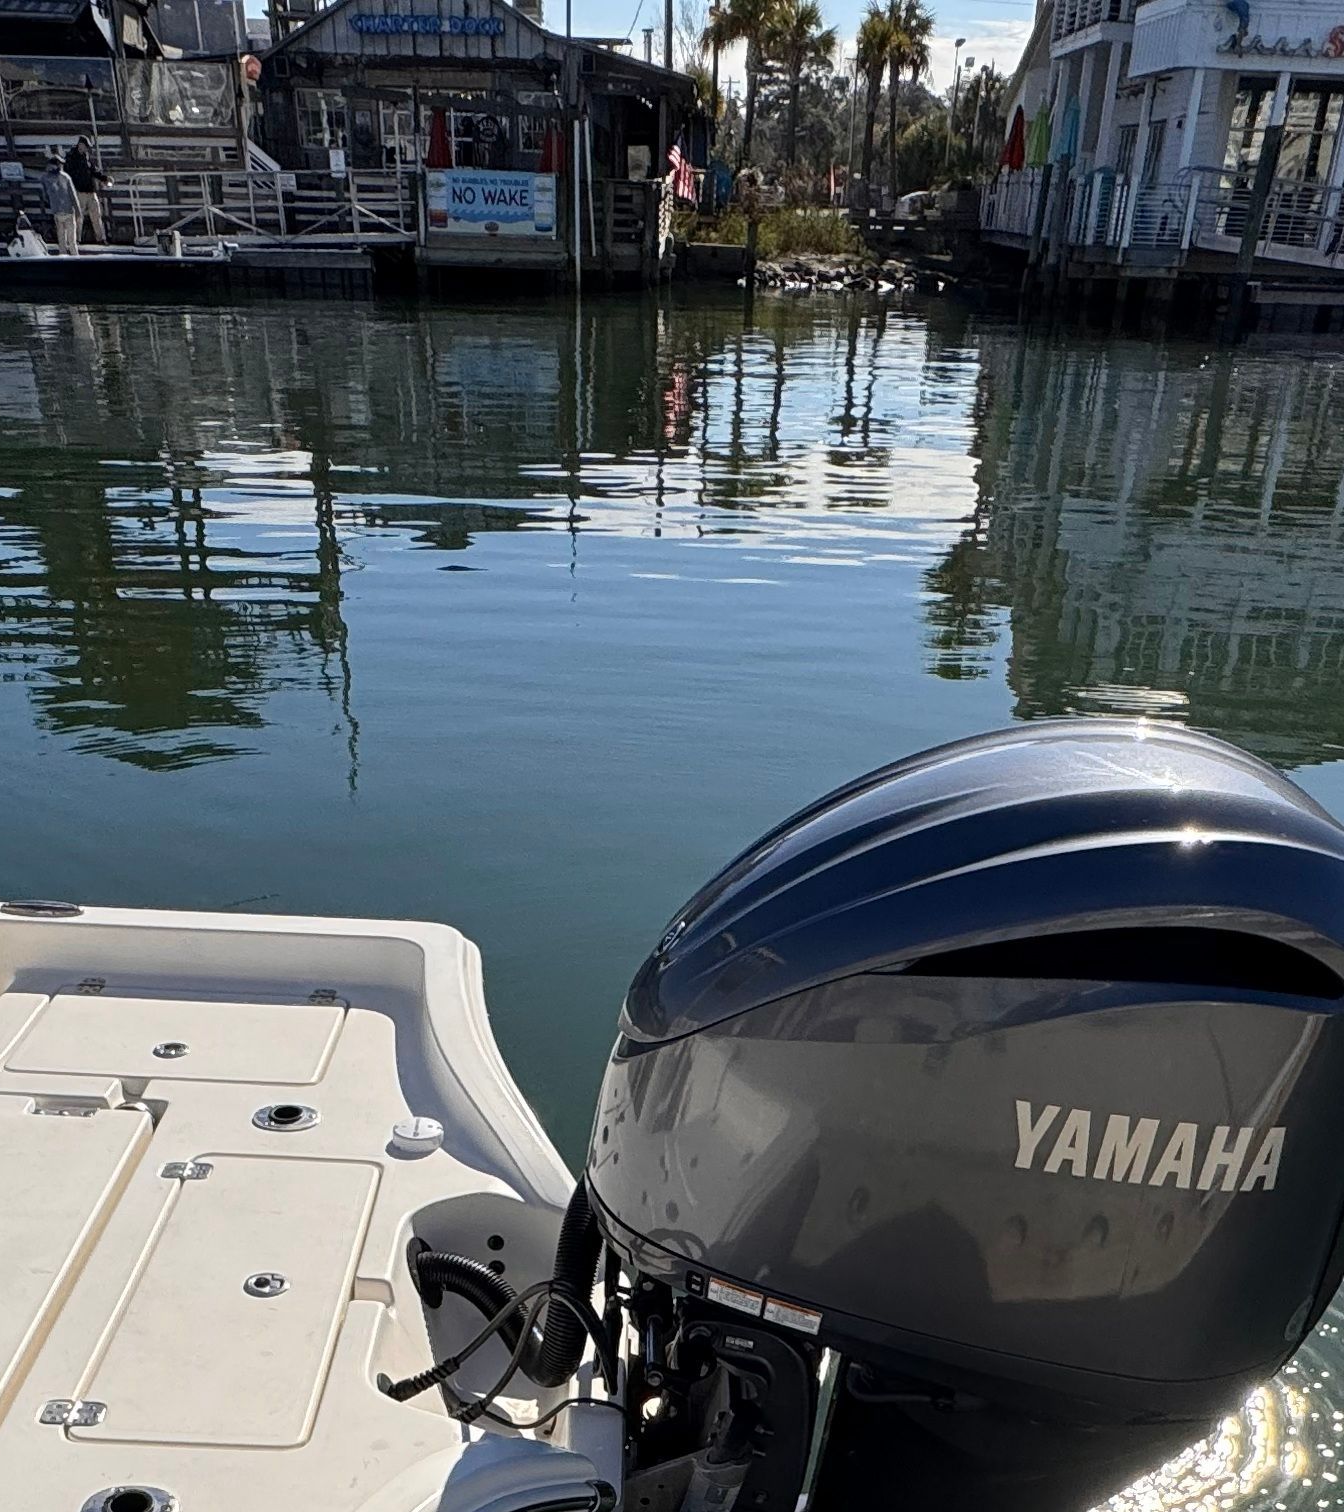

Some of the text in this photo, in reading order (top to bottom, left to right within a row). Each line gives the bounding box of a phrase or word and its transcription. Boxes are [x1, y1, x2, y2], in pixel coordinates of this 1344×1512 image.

[350, 14, 504, 36] CHARTER DOCK
[452, 187, 529, 207] NO WAKE
[1014, 1100, 1287, 1192] YAMAHA
